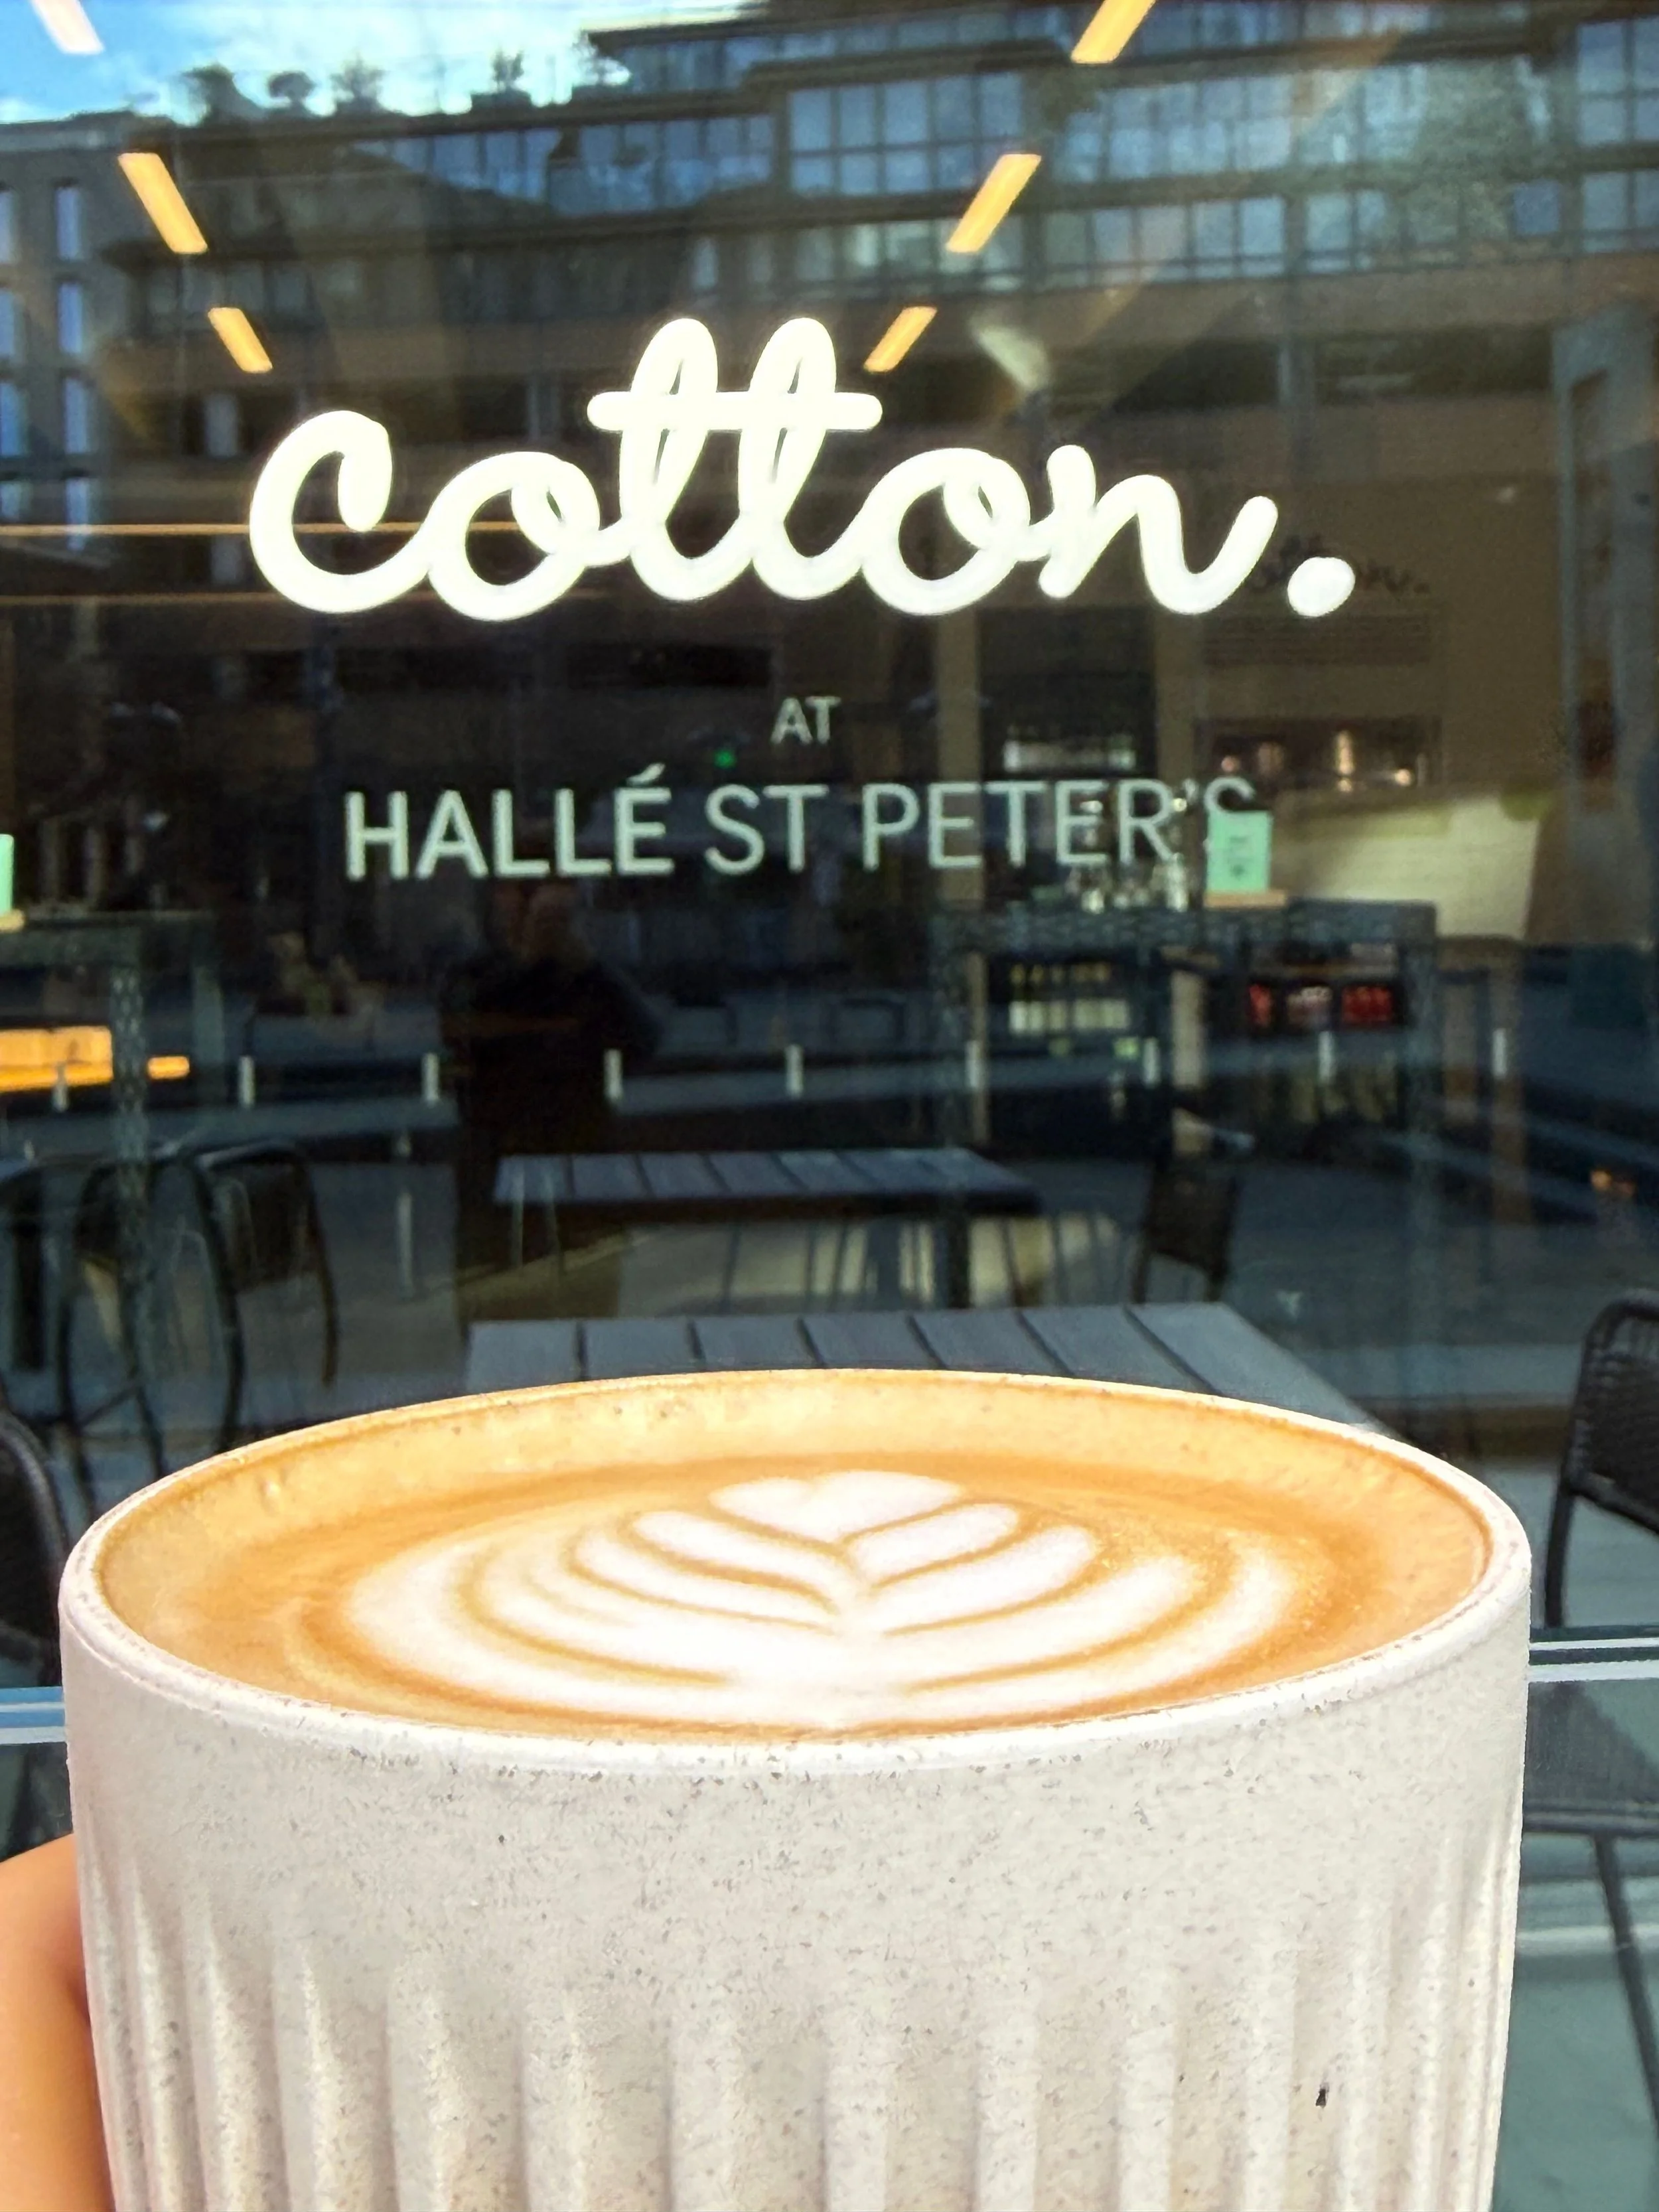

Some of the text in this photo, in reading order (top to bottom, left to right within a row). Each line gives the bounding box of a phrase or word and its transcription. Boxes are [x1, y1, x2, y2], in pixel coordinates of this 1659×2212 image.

[249, 317, 1356, 623] cotton.
[770, 695, 841, 745] AT
[344, 762, 675, 881] HALLÉ
[703, 783, 830, 875] ST
